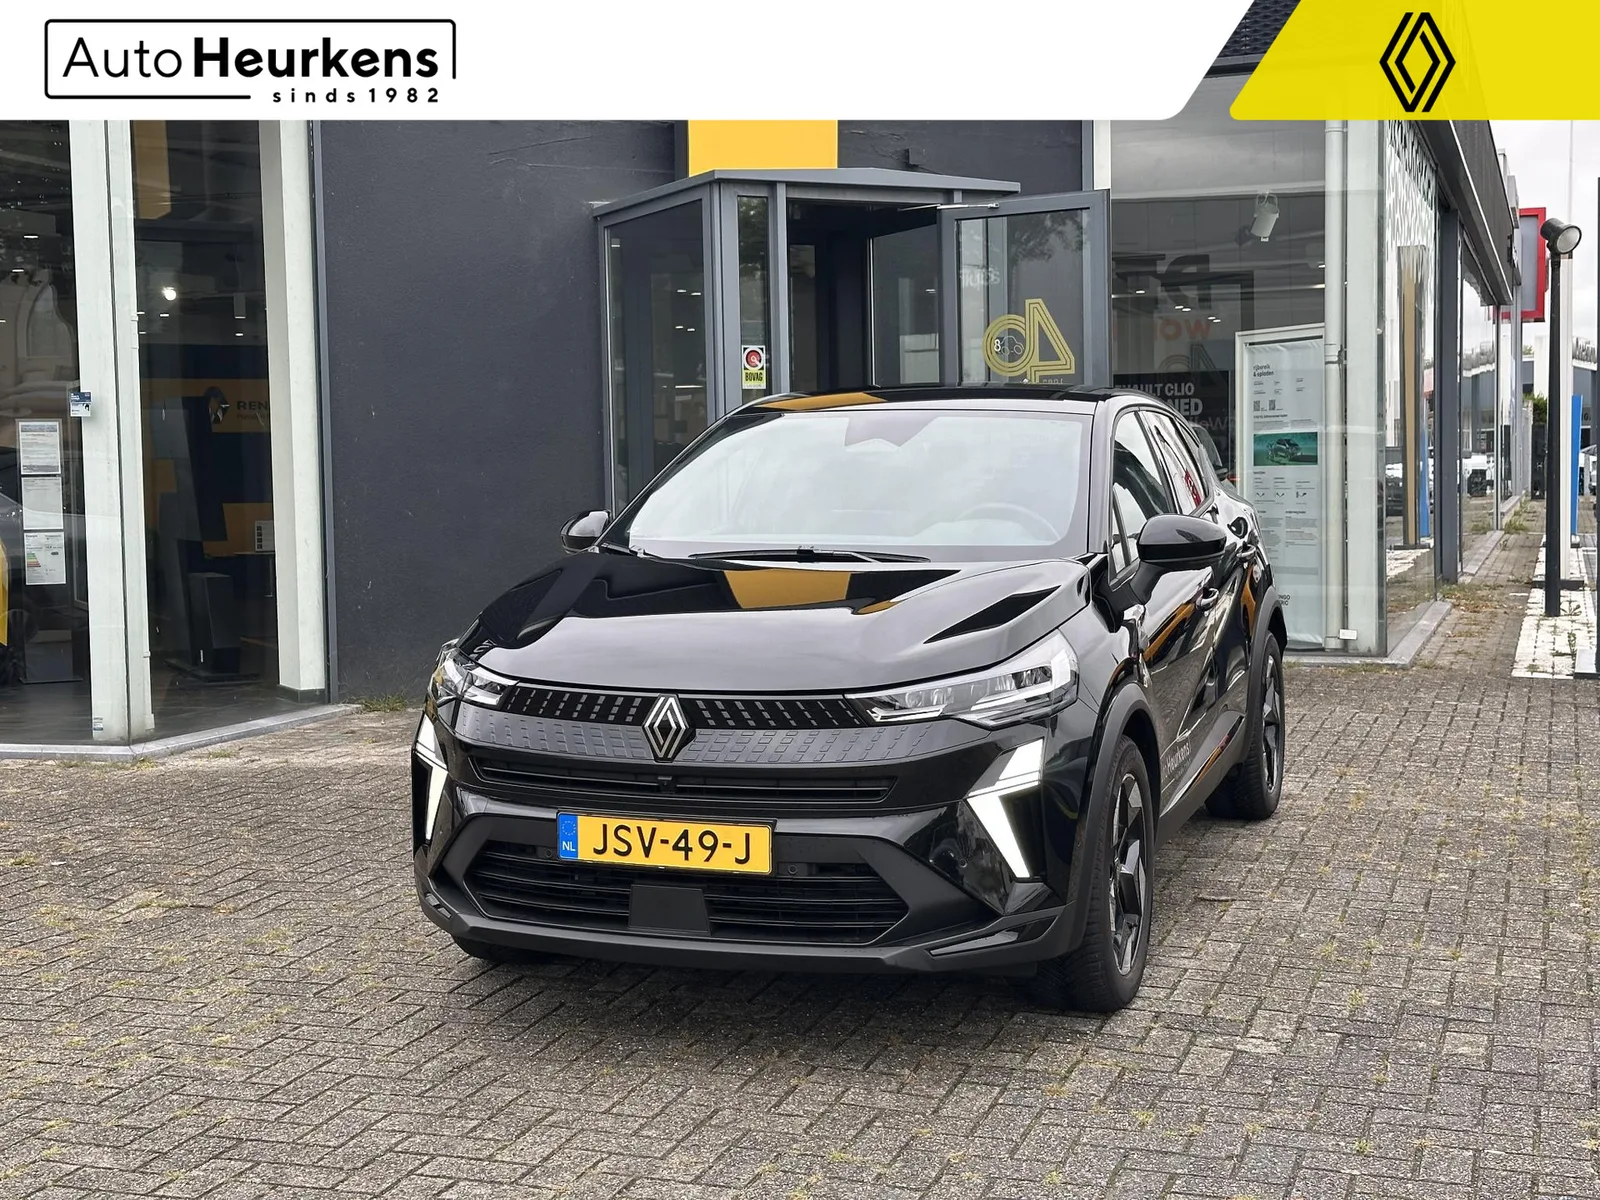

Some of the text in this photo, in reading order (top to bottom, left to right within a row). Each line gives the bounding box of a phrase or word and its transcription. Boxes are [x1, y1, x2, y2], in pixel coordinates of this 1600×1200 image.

[745, 372, 763, 382] BOVAG
[1165, 382, 1195, 396] CLIO
[1167, 399, 1203, 416] NED
[562, 841, 576, 852] NL
[593, 823, 750, 865] JSV-49-J
